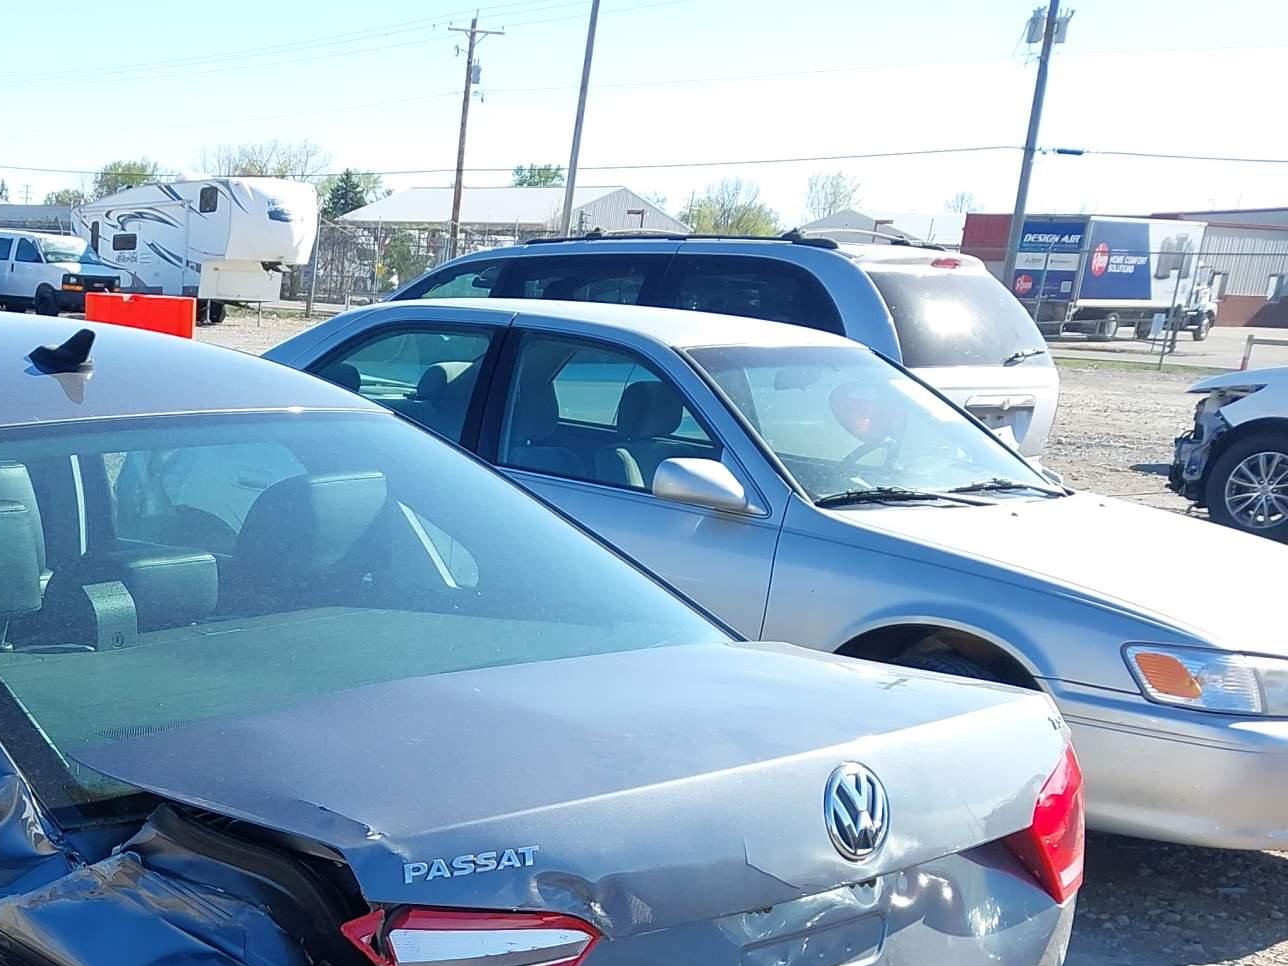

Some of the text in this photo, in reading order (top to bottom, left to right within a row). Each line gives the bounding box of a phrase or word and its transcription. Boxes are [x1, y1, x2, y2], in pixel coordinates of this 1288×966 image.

[1023, 233, 1081, 244] DESIGN AIR
[402, 845, 540, 885] PASSAT
